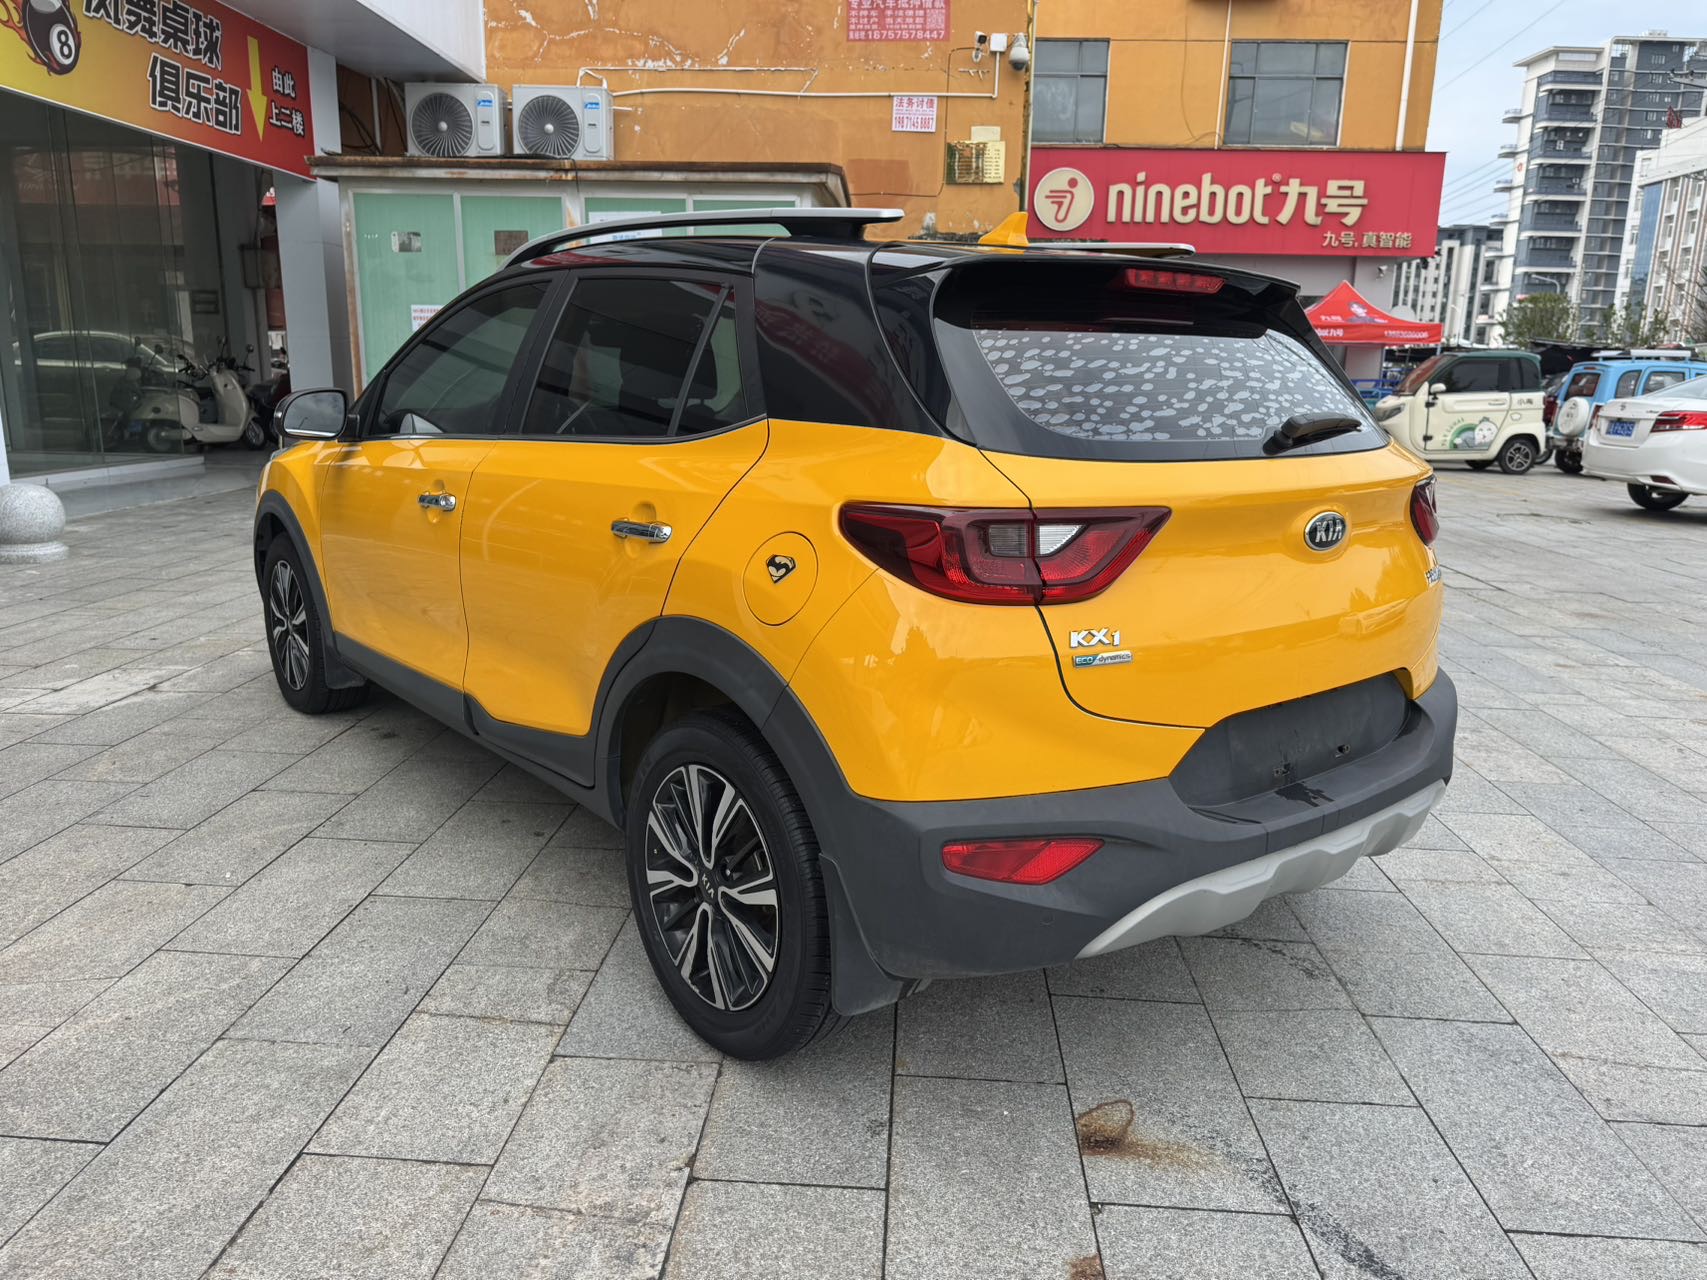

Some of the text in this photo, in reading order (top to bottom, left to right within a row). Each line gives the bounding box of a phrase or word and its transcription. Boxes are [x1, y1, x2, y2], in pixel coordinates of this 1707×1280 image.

[59, 29, 71, 58] 8
[147, 52, 243, 136] 俱乐部
[271, 66, 296, 98] 由此
[269, 101, 305, 136] 上二楼
[1106, 171, 1369, 227] ninebot 九号
[1315, 519, 1342, 543] KIA
[1070, 628, 1121, 648] KX1
[701, 872, 715, 899] KIA
